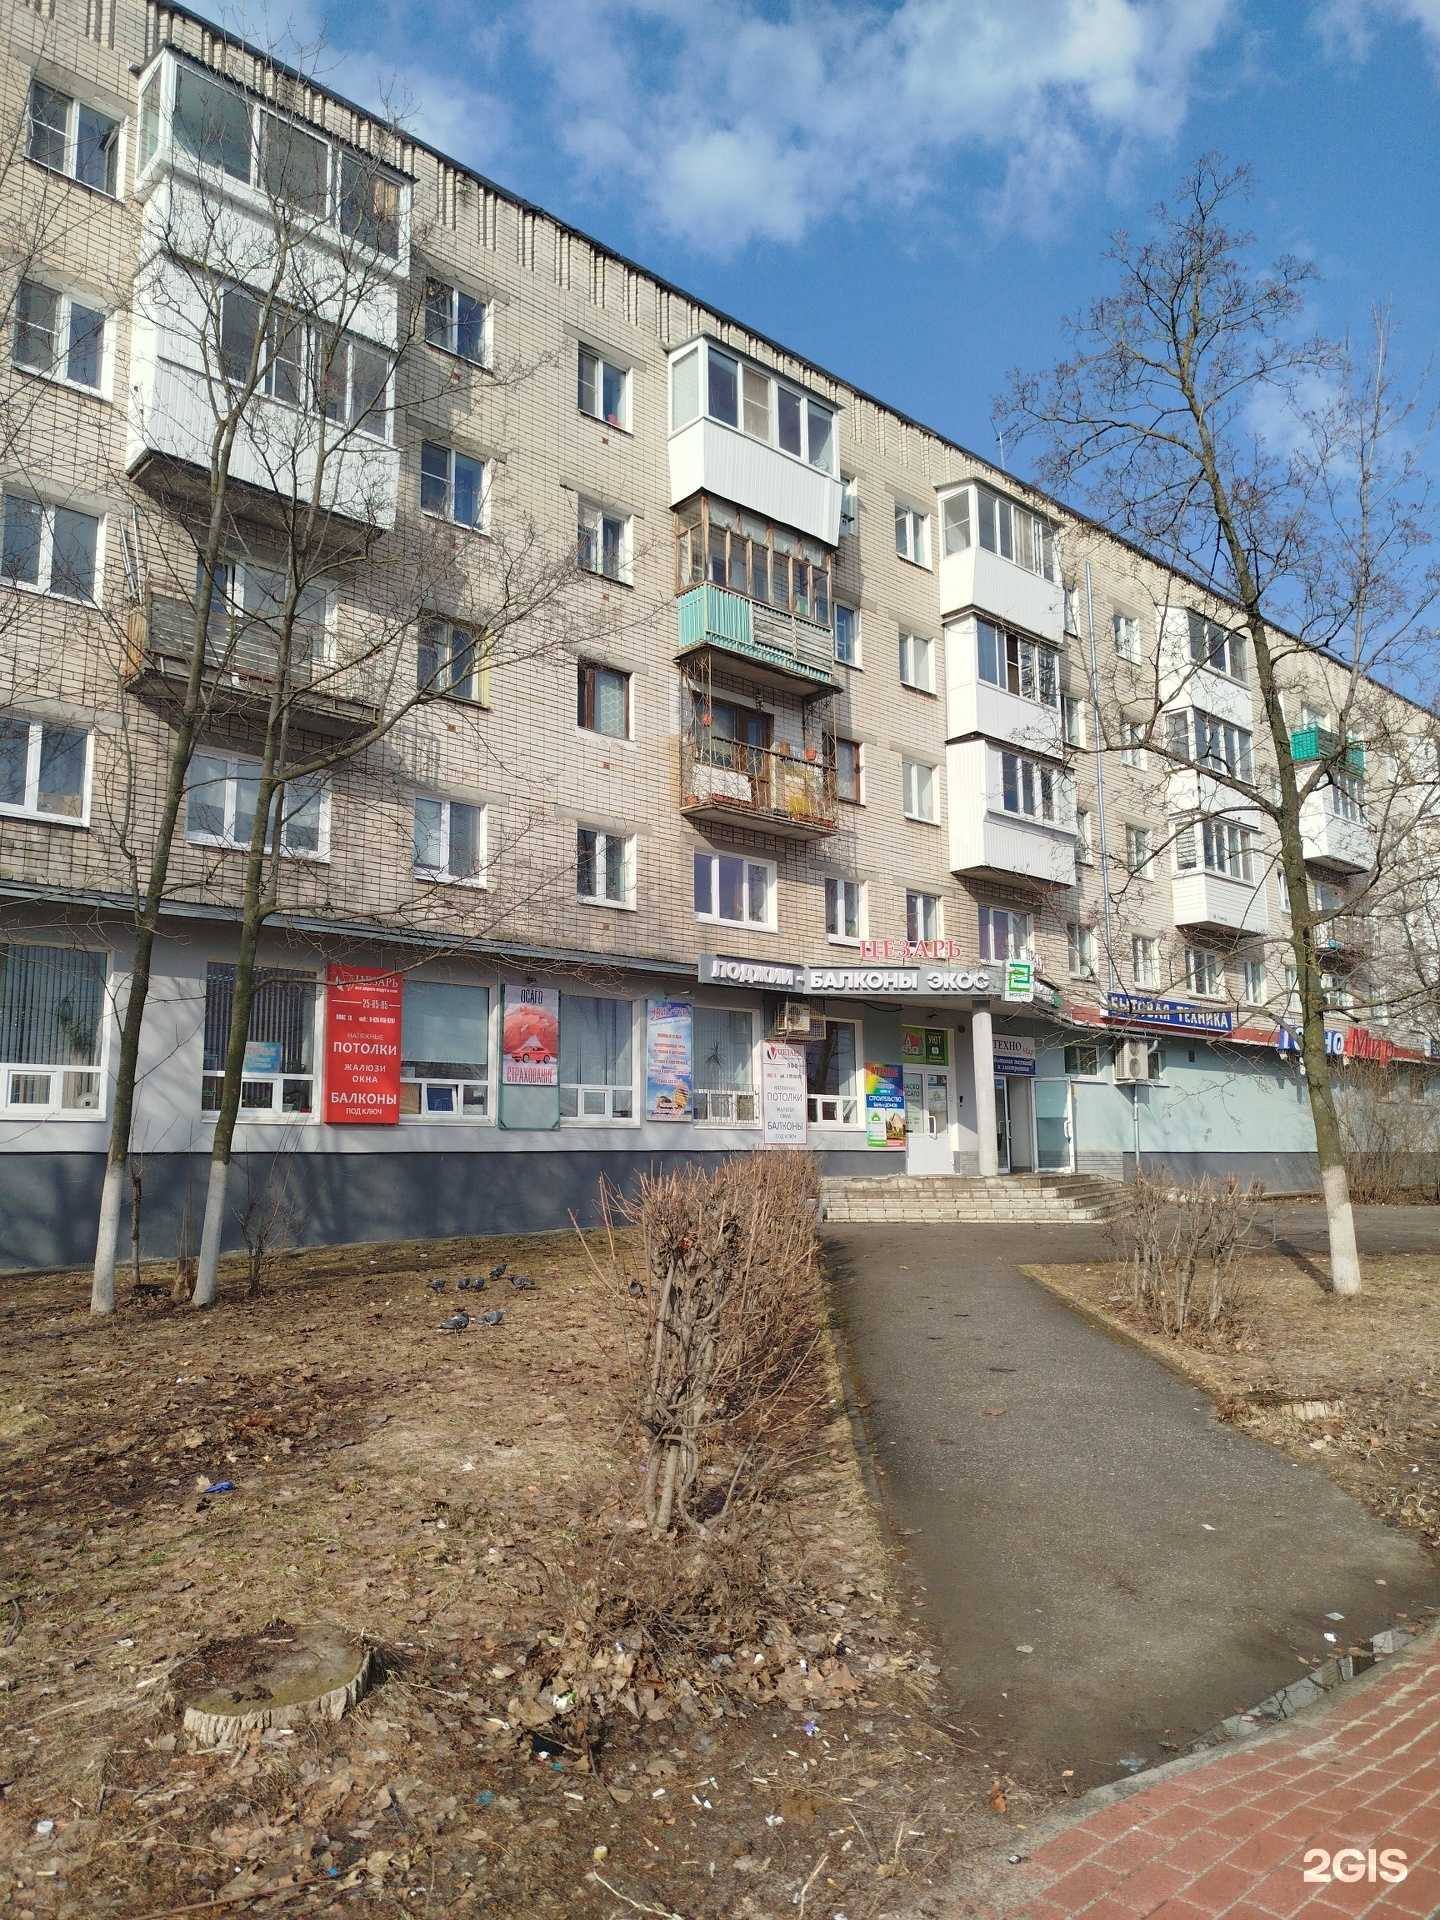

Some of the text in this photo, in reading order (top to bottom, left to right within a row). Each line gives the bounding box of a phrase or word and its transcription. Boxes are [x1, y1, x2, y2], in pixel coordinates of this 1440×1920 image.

[859, 938, 961, 961] ЦЕЗАРЬ
[711, 959, 793, 985] ЛОДЖИИ
[811, 971, 918, 992] БАЛКОНЫ
[927, 971, 992, 992] ЭКОС
[521, 989, 543, 1004] ОСАГО
[333, 1042, 397, 1055] ПОТОЛКИ
[992, 1039, 1022, 1050] ТЕХНО
[344, 1064, 386, 1072] ЖАЛЮЗИ
[352, 1075, 378, 1083] ОКНА
[331, 1092, 397, 1105] БАЛКОНЫ
[768, 1092, 803, 1102] ПОТОЛКИ
[768, 1121, 803, 1130] БАЛКОНЫ
